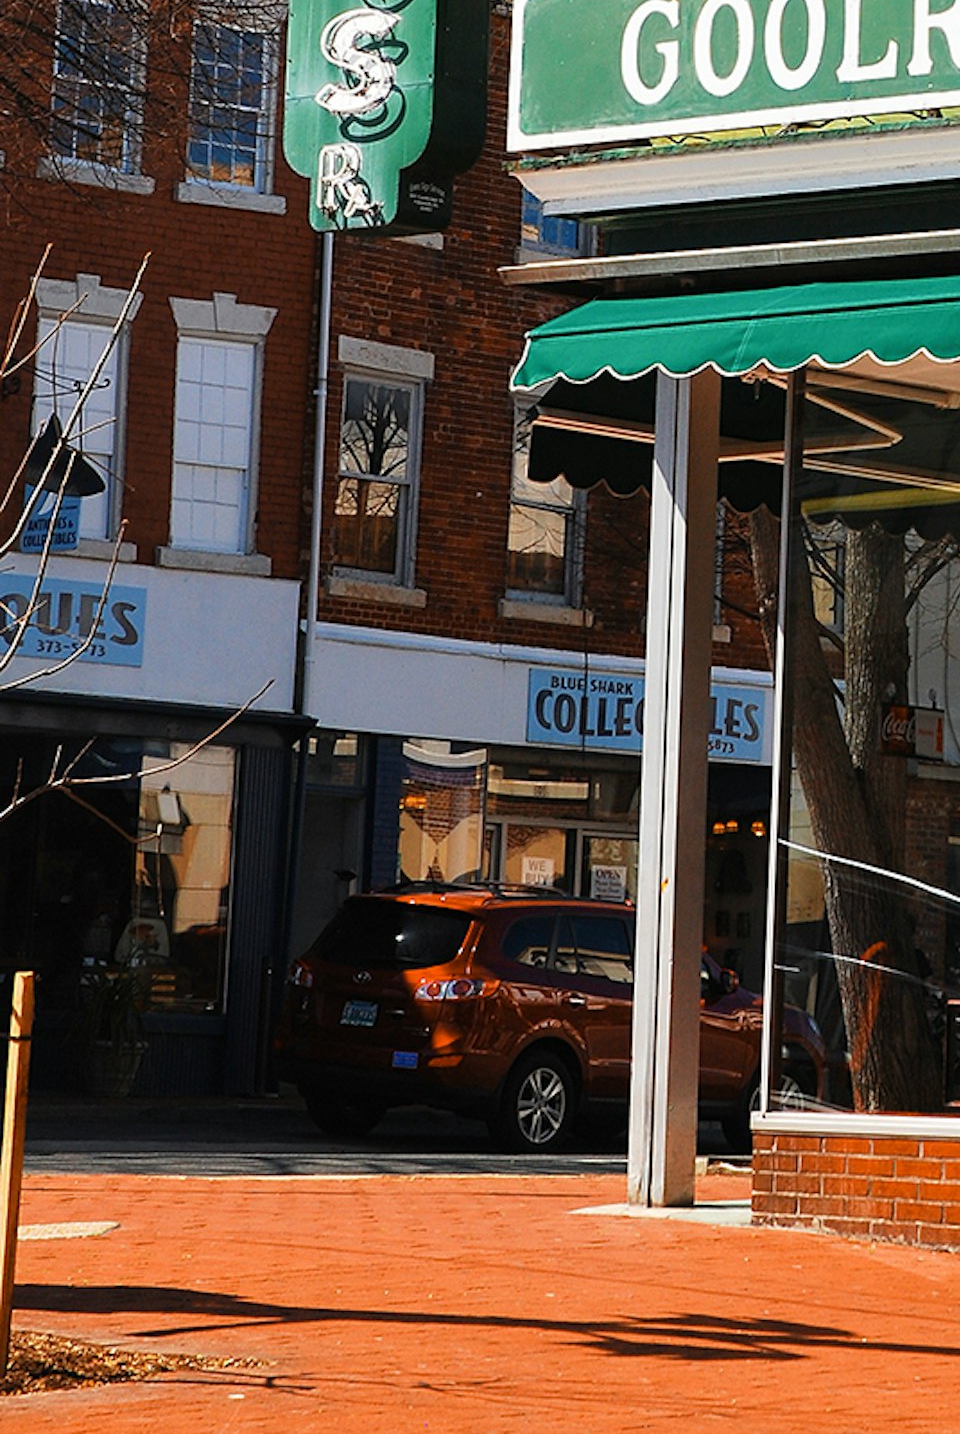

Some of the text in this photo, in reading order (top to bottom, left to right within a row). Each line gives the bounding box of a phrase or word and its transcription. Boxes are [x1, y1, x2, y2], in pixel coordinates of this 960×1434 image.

[28, 517, 67, 532] ANTIES
[23, 531, 77, 547] COLLEIBLES
[0, 593, 138, 646] QUES
[37, 639, 106, 657] 373-573
[551, 675, 634, 696] BLUE SHARK
[535, 689, 759, 742] COLLECLES
[528, 859, 546, 872] WE
[596, 869, 621, 879] OPEN
